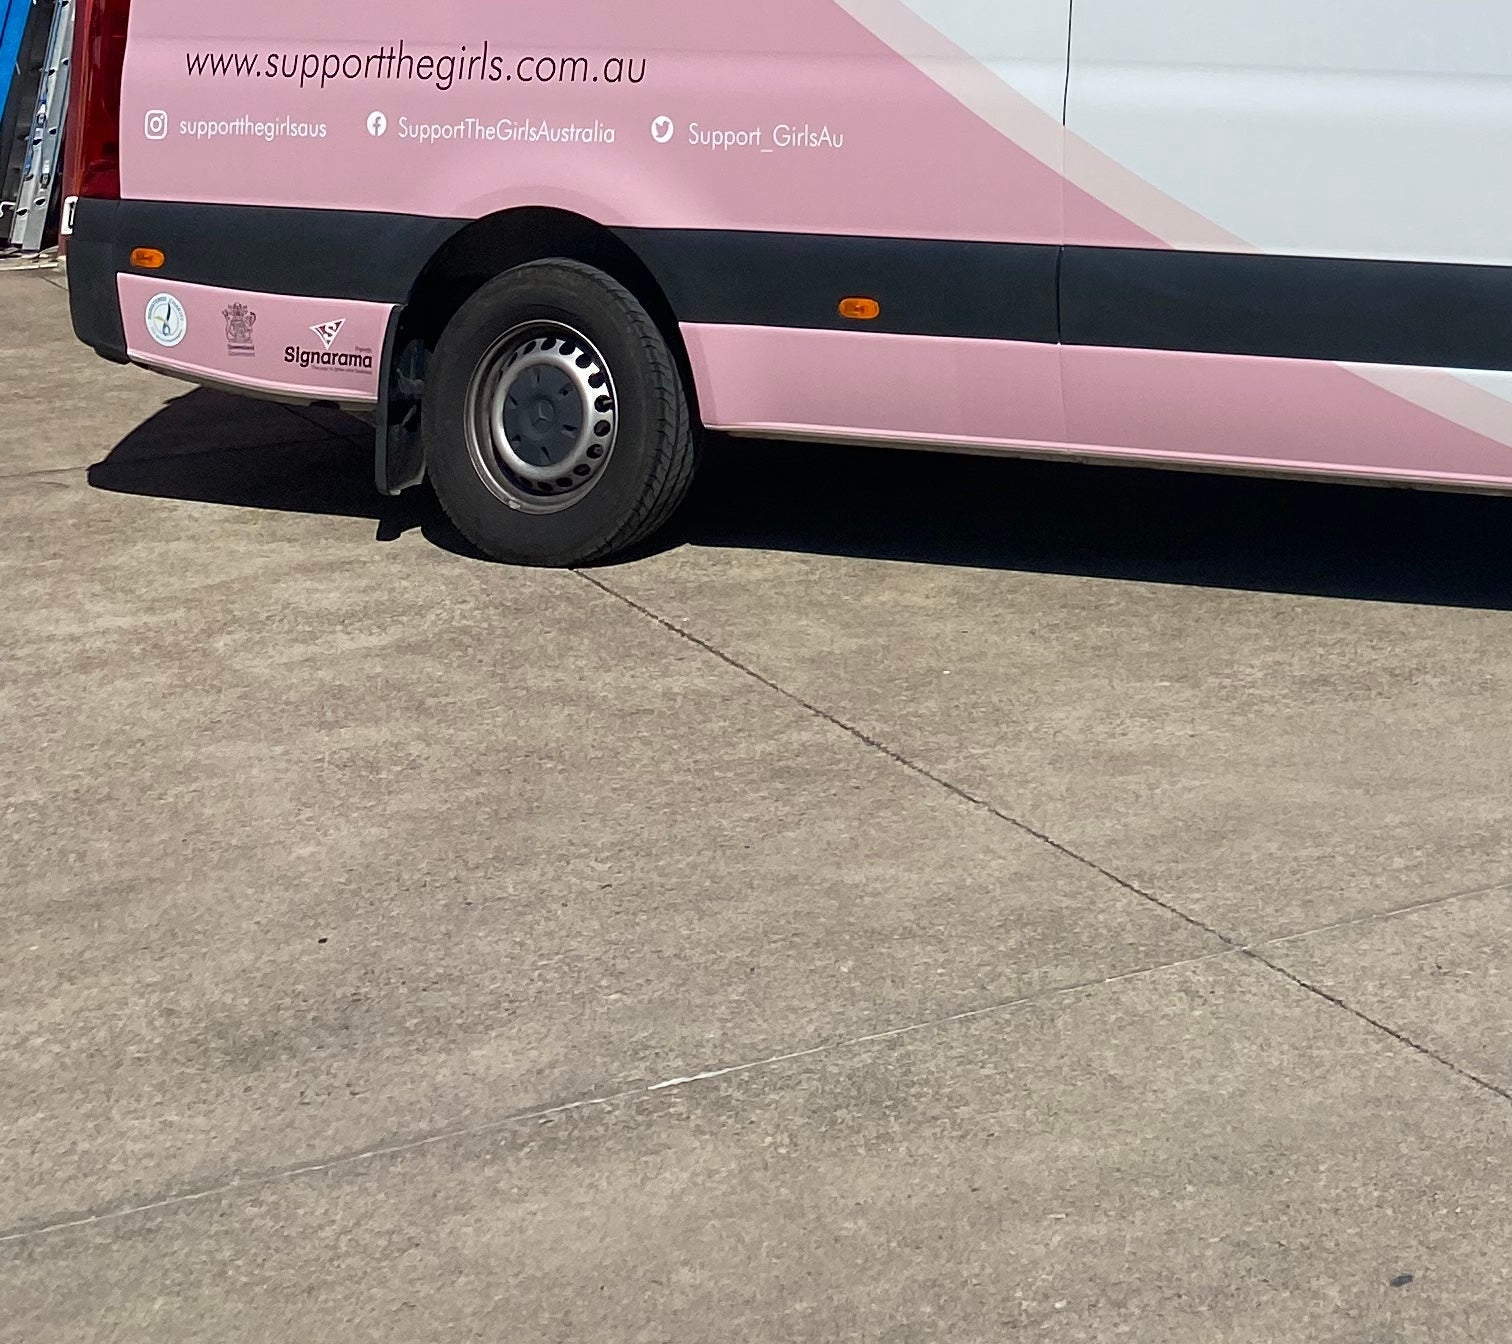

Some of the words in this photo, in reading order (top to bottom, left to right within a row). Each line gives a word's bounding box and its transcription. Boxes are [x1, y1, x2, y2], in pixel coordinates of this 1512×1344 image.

[186, 39, 646, 90] www.supportthegirls.com.au
[179, 114, 327, 141] supportthegirlsaus
[398, 116, 616, 143] SupportTheGirlsAustralia
[688, 122, 844, 152] Support_GirlsAu
[284, 346, 373, 369] Signarama
